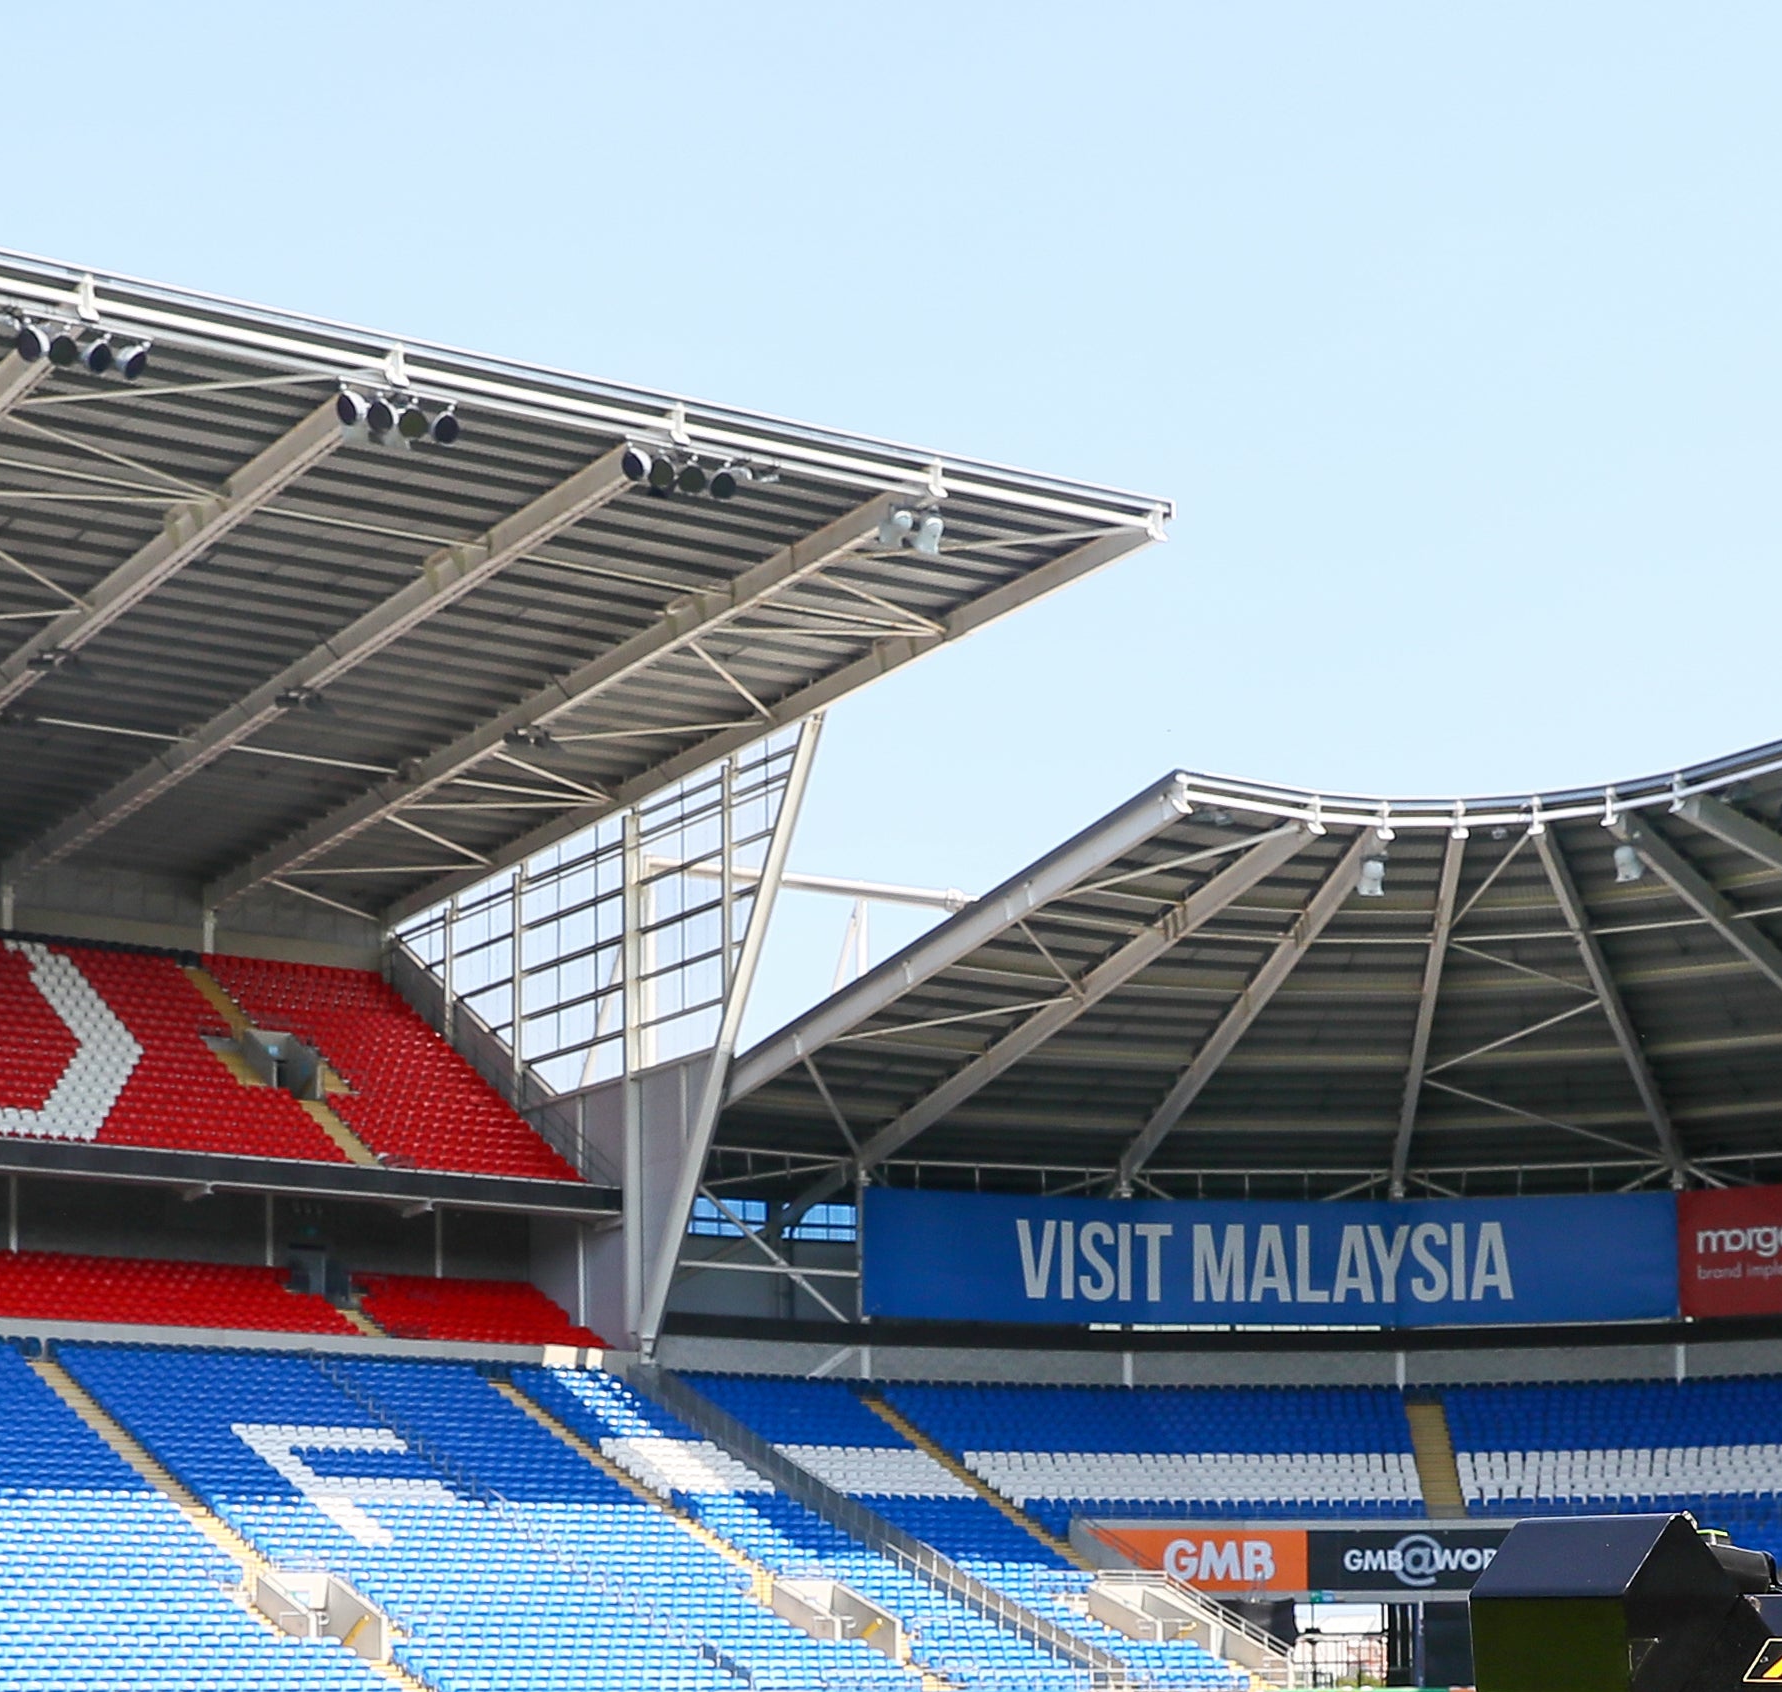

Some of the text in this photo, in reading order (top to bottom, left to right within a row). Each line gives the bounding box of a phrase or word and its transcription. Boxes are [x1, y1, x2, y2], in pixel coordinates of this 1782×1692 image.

[1016, 1219, 1514, 1303] VISIT MALAYSIA
[1697, 1264, 1743, 1281] brand
[1163, 1538, 1276, 1582] GMB
